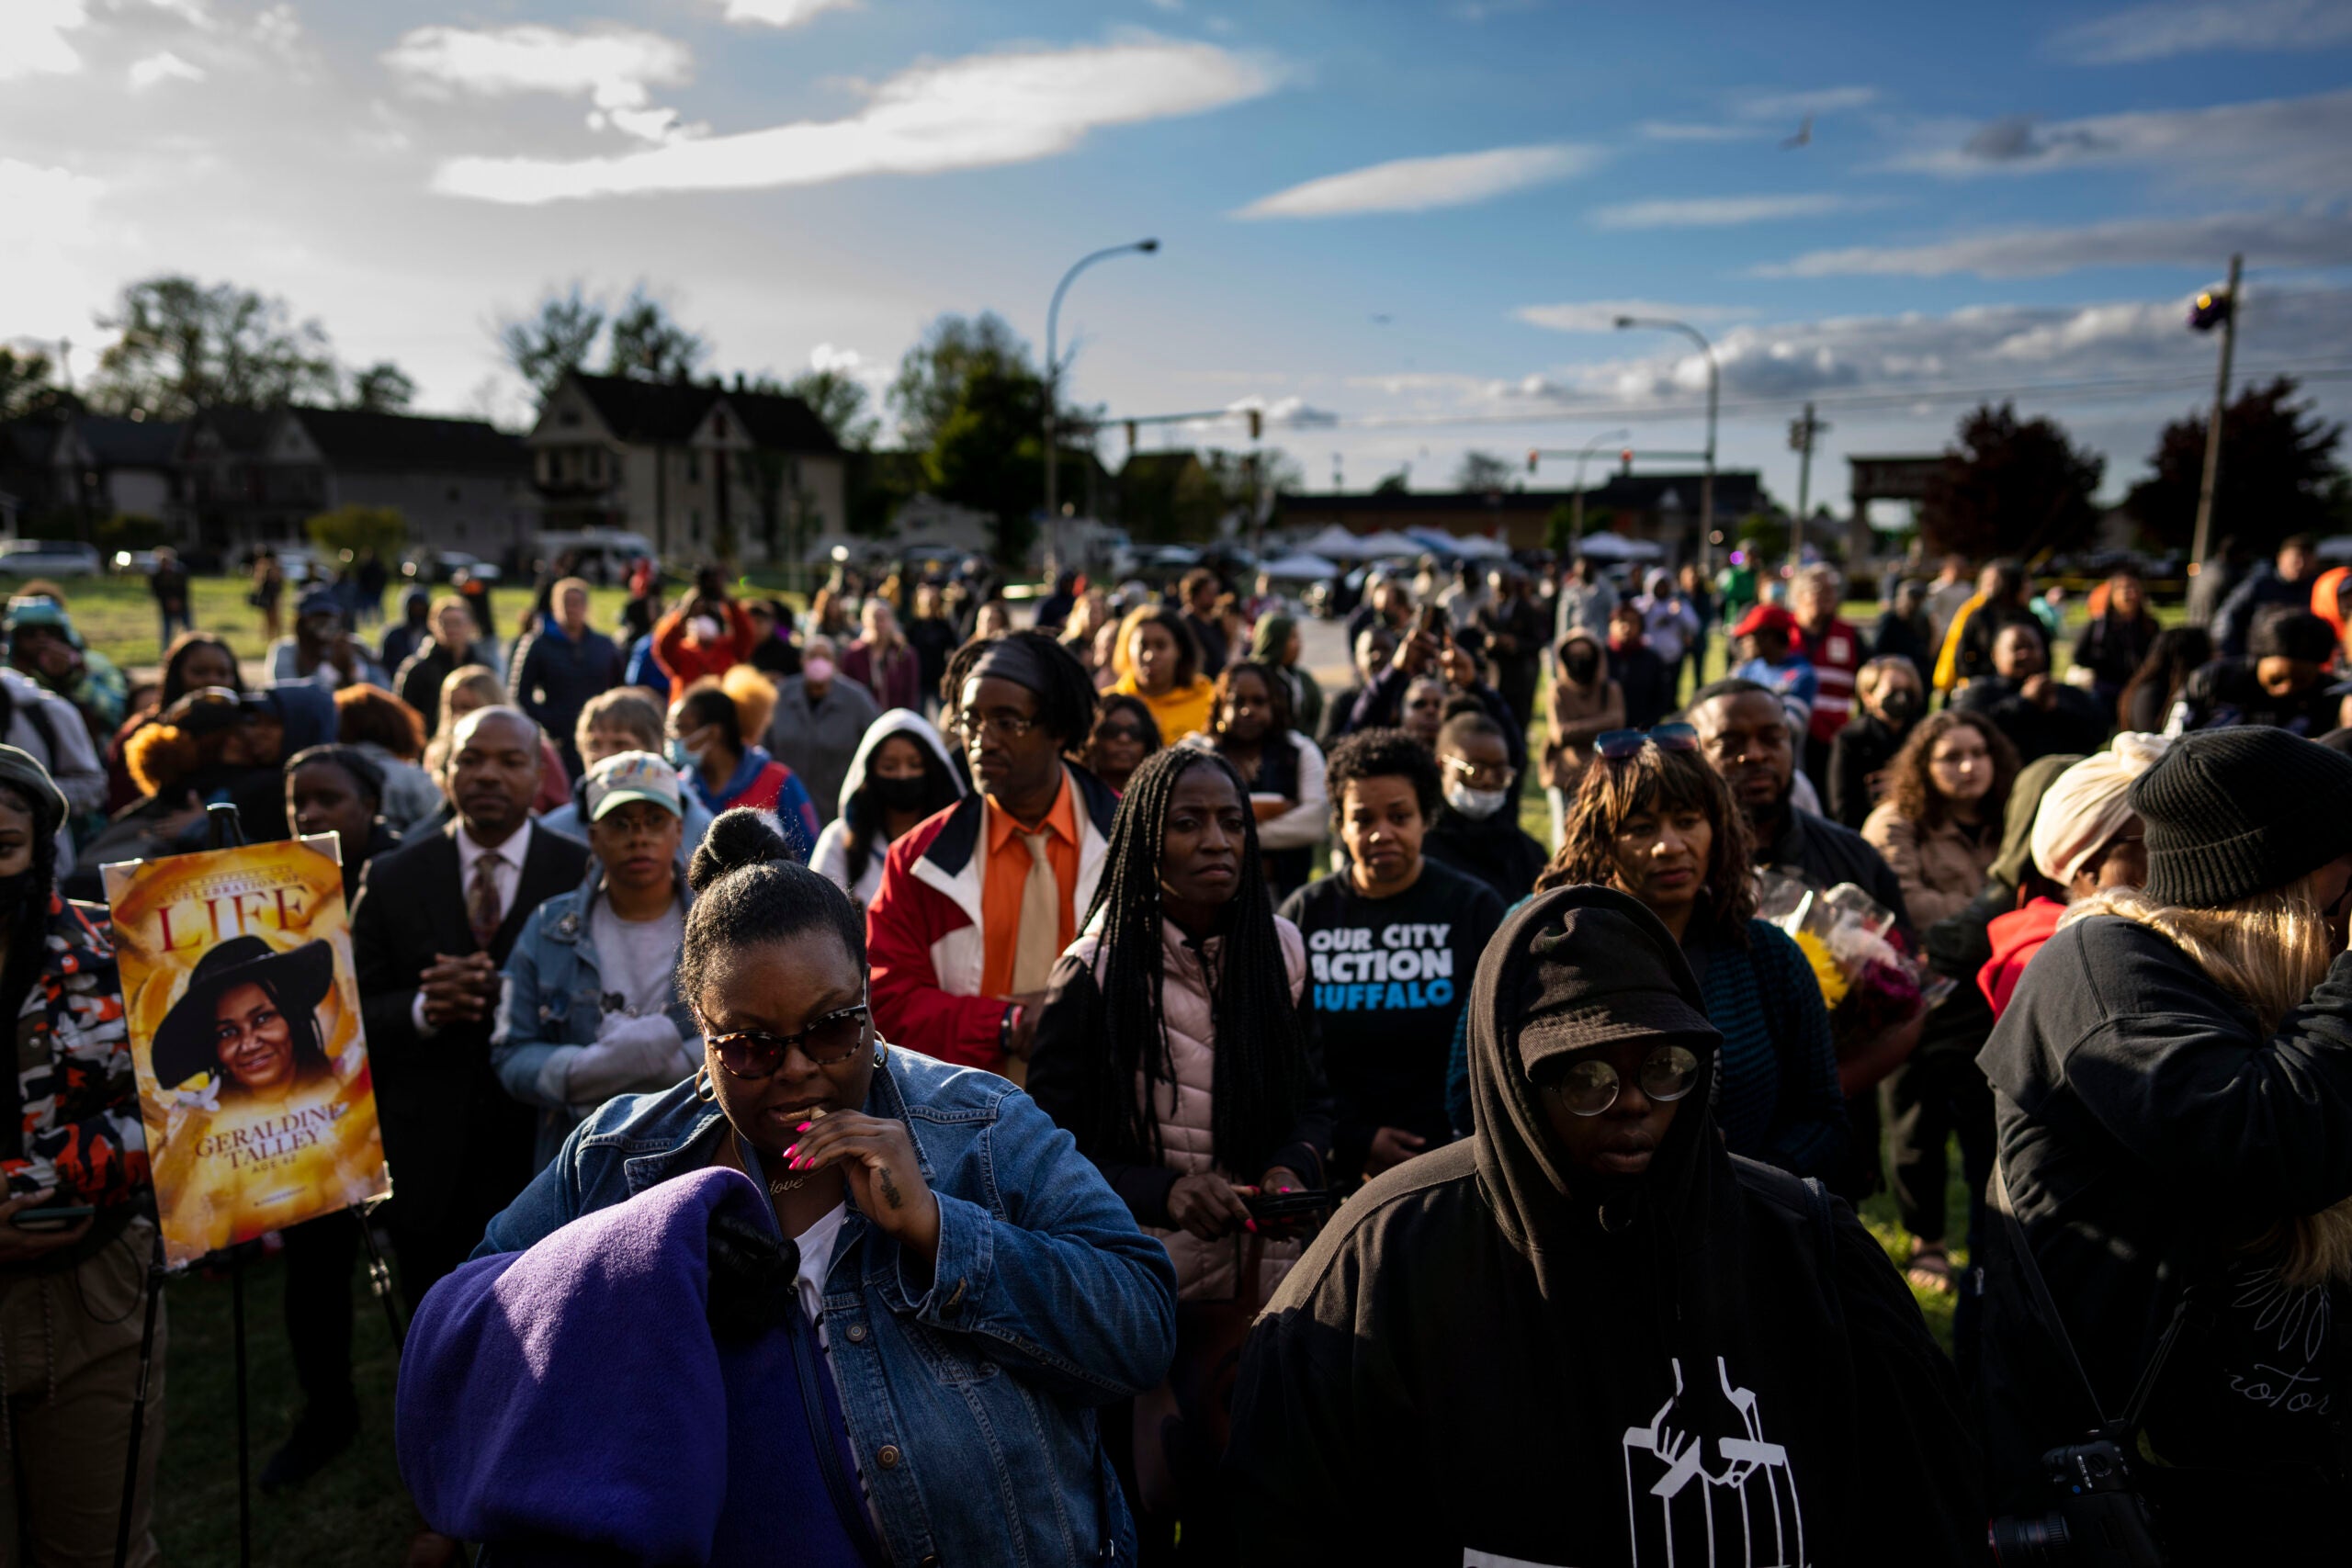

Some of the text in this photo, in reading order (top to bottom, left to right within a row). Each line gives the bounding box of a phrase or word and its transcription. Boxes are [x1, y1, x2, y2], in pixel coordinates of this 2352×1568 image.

[156, 884, 314, 953] LIFE
[1307, 922, 1452, 953] OUR CITY
[1310, 947, 1454, 984] ACTION
[194, 1102, 340, 1157] GERALDINE
[224, 1125, 321, 1169] TALLEY
[251, 1159, 277, 1174] AGE
[769, 1177, 805, 1195] love
